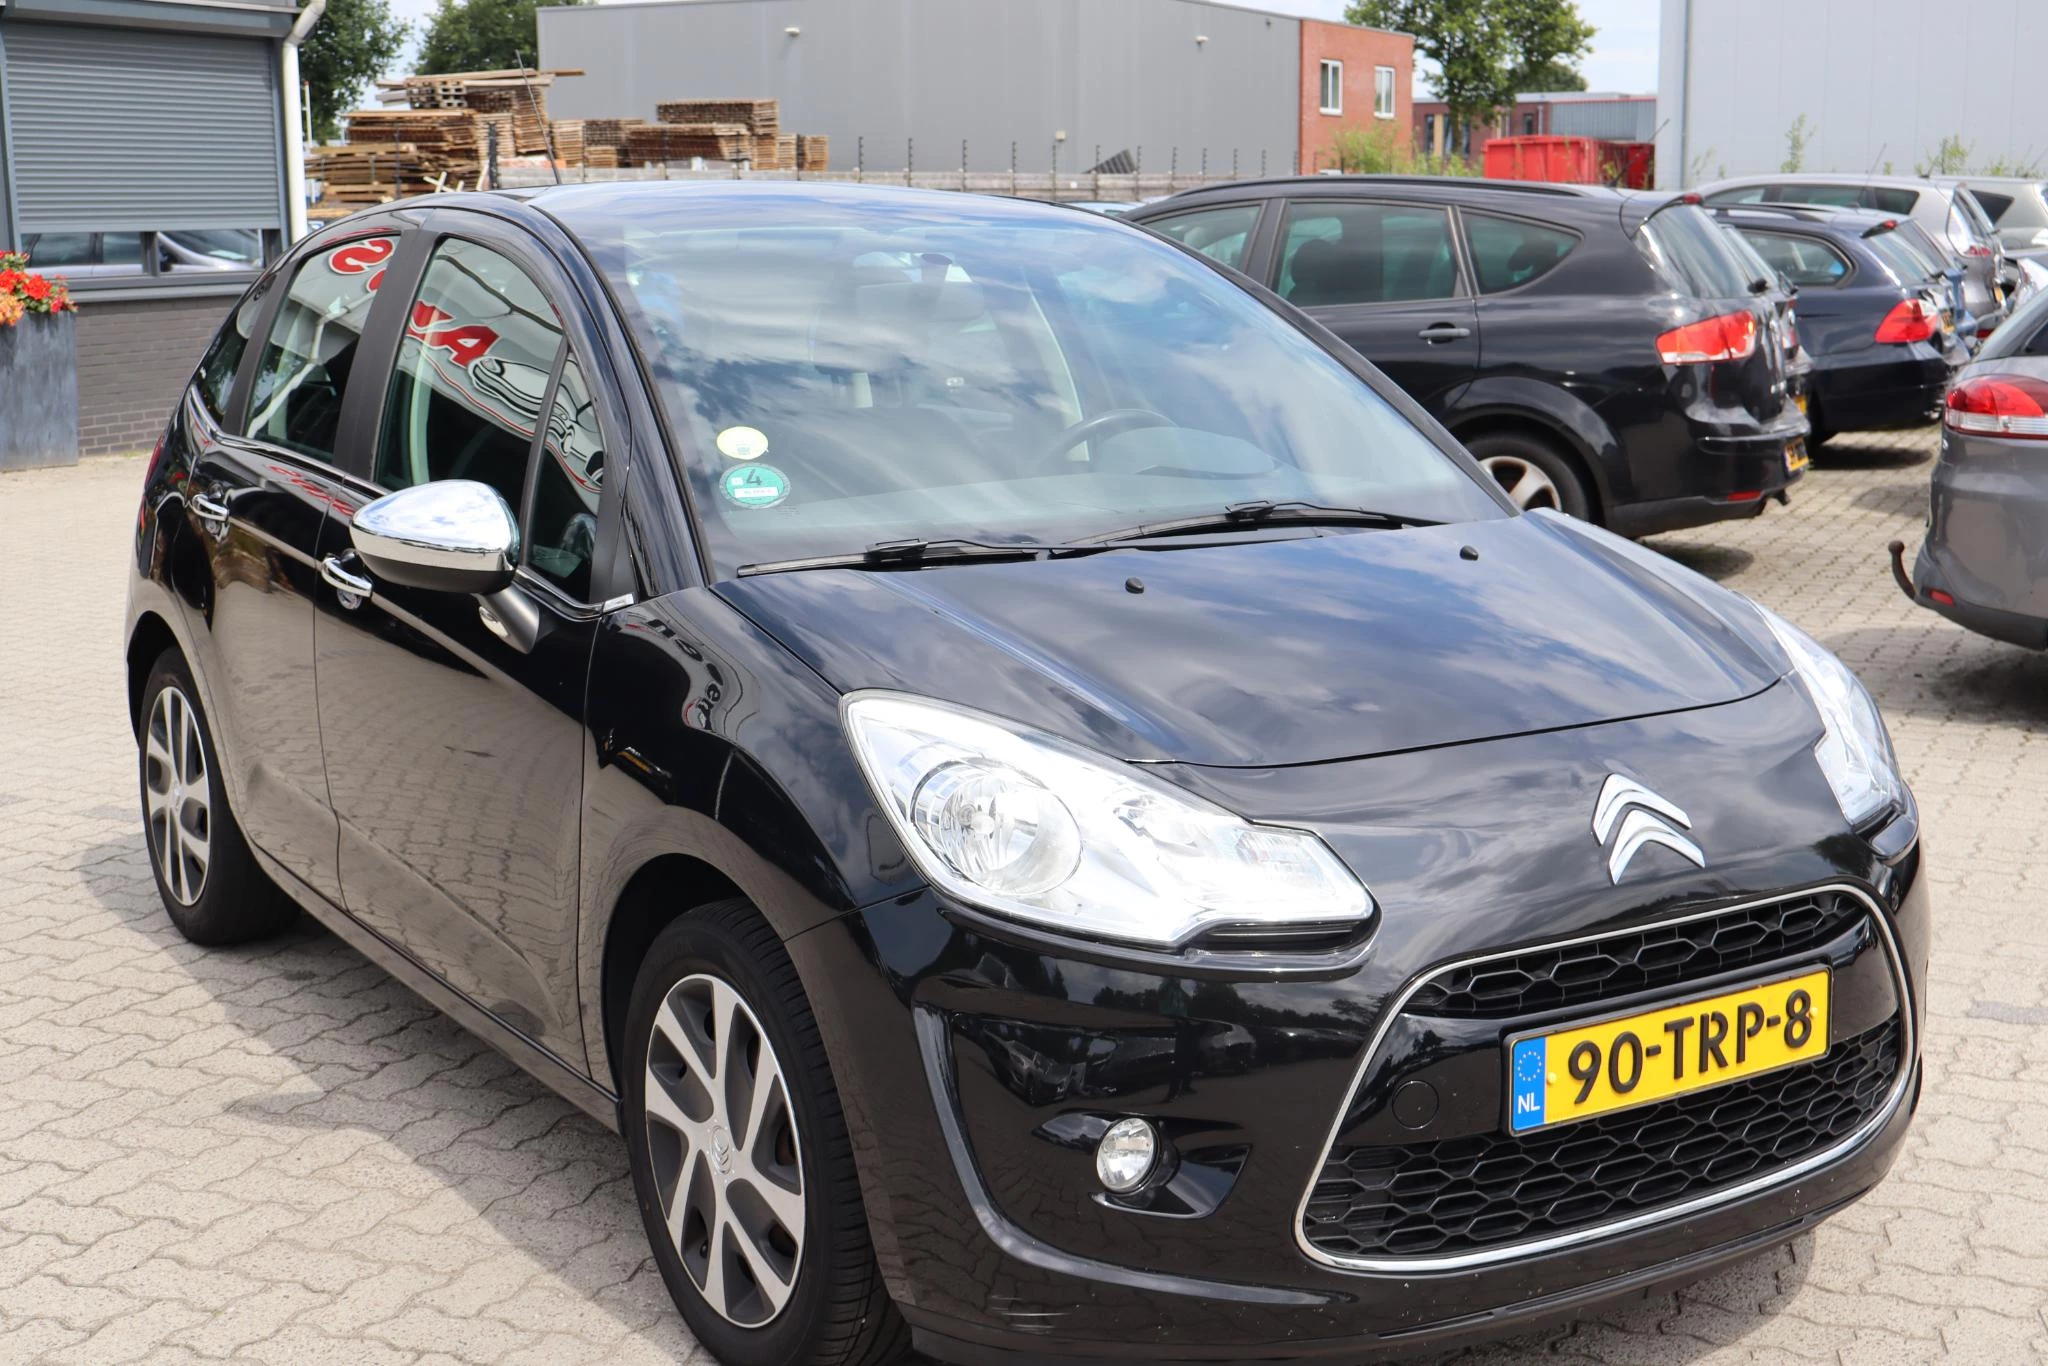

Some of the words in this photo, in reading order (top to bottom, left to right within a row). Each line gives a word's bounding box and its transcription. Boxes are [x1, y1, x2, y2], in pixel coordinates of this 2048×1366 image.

[747, 468, 762, 485] 4
[1568, 989, 1812, 1104] 90-TRP-8
[1517, 1091, 1541, 1115] NL
